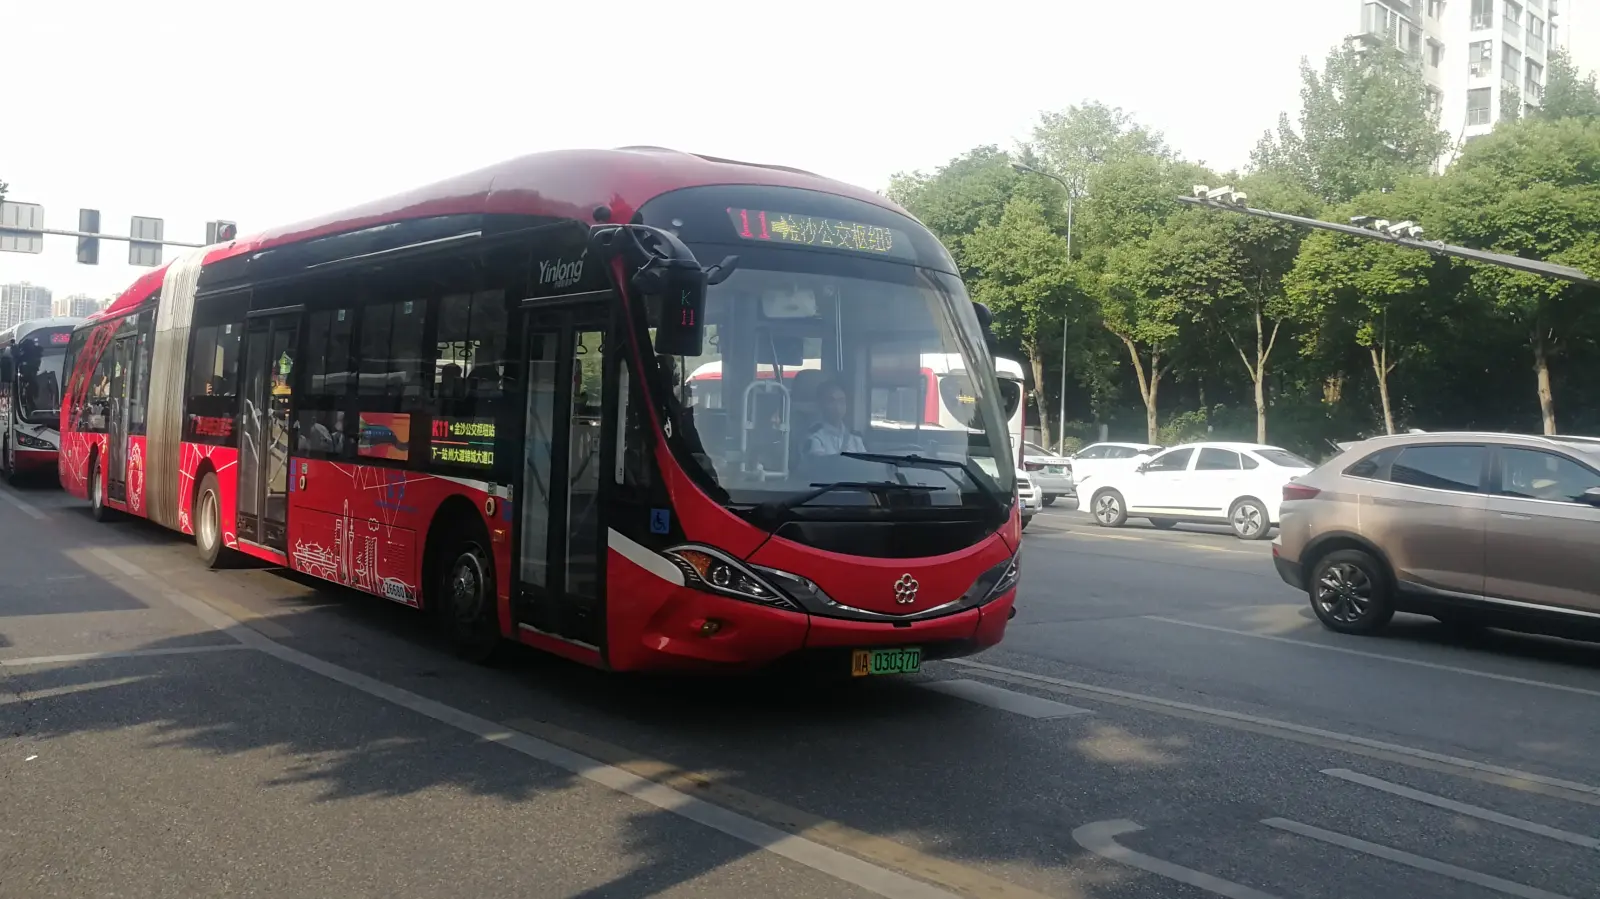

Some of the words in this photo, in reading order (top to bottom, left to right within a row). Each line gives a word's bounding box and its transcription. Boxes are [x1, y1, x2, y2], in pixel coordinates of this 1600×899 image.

[539, 257, 584, 284] Yinlong
[681, 289, 692, 306] K
[681, 308, 695, 326] 11
[432, 420, 448, 437] K11
